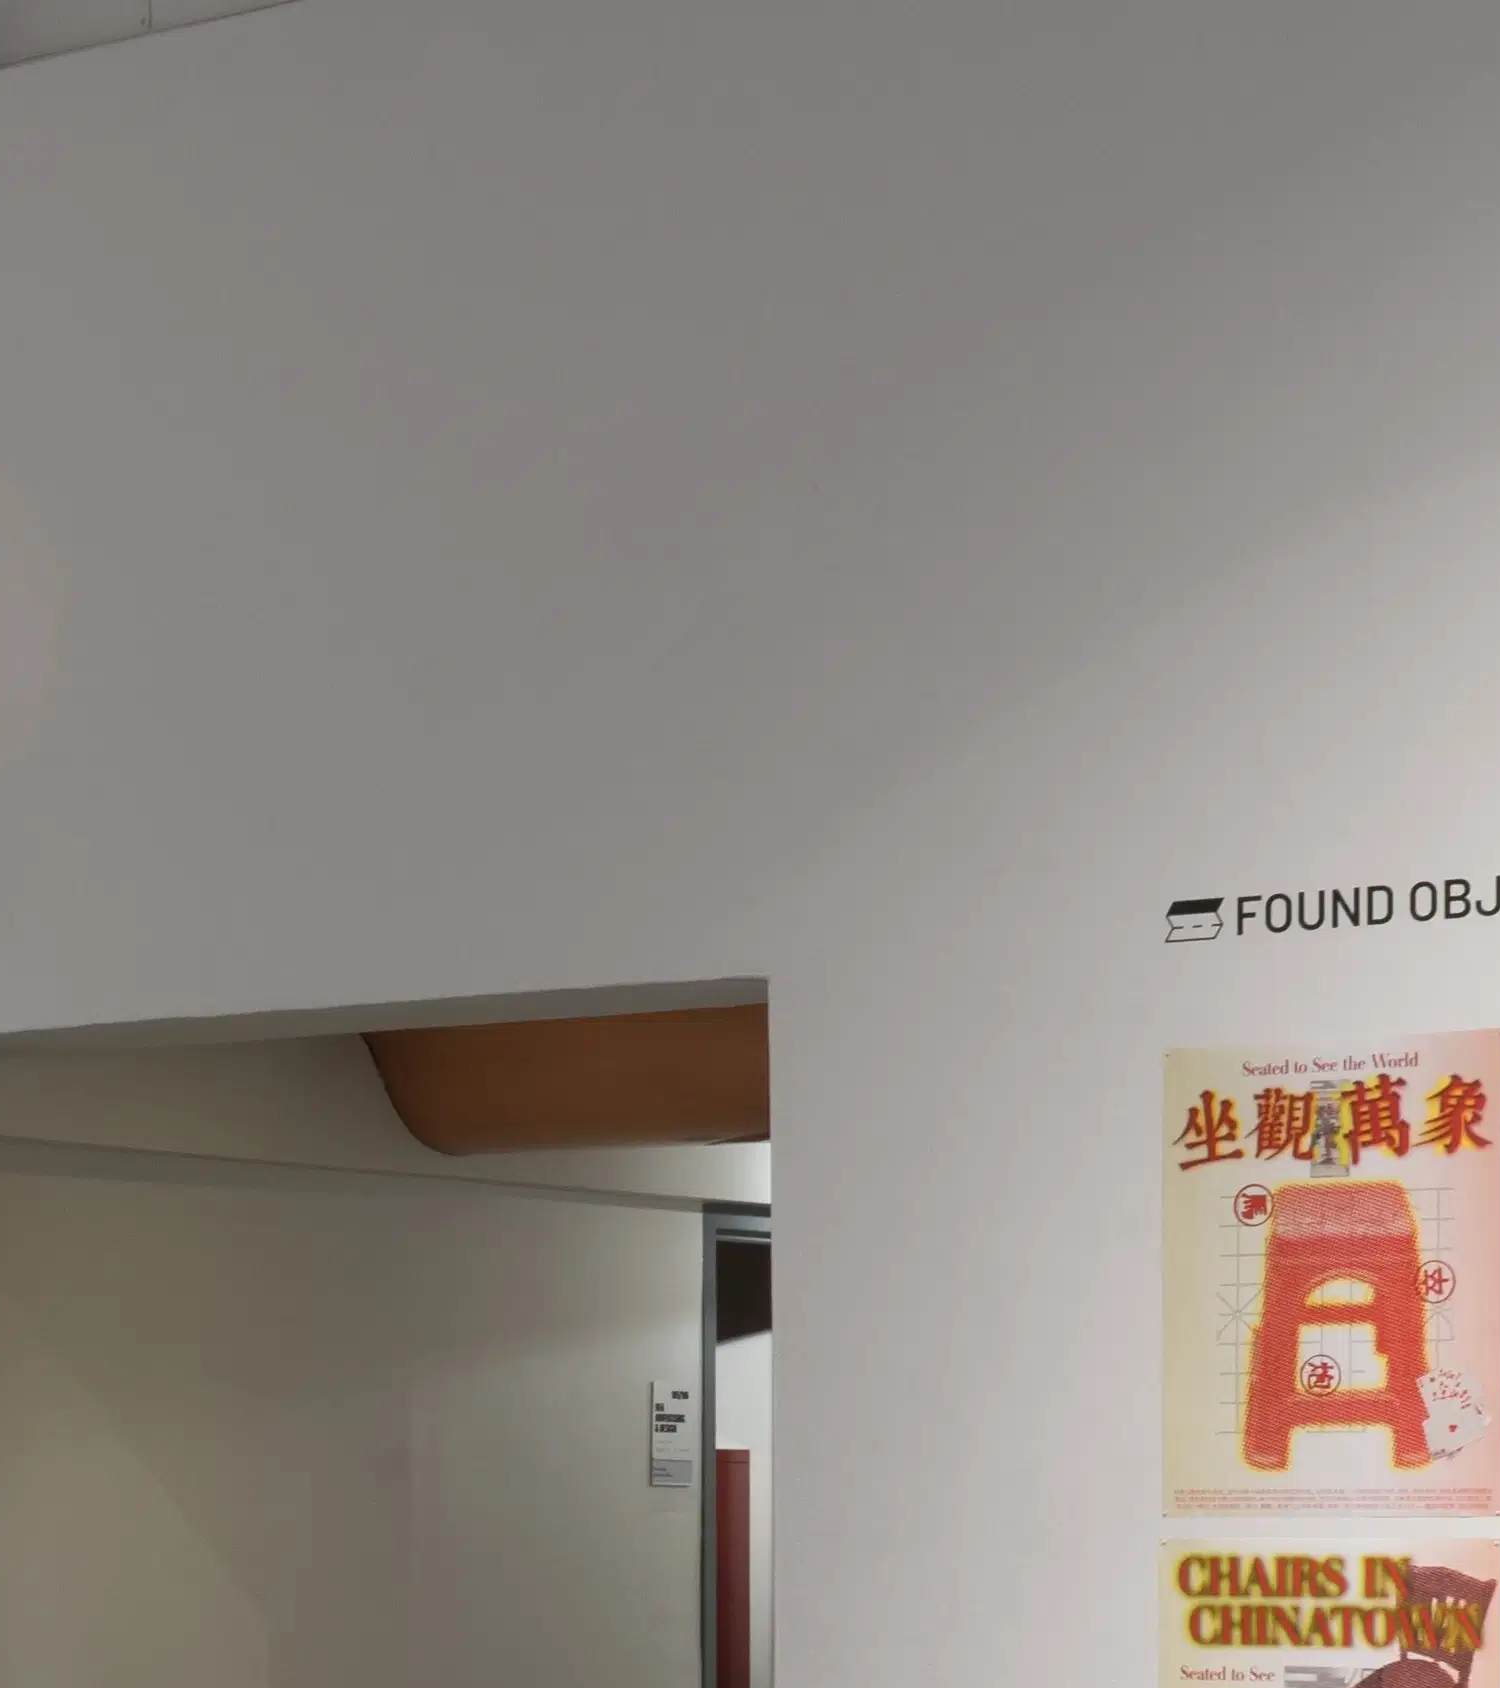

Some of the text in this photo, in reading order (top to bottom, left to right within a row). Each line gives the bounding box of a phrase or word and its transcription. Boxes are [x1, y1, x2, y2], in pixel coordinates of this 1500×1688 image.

[1236, 884, 1394, 936] FOUND
[1242, 1051, 1420, 1077] Seated to See the World
[1172, 1072, 1494, 1172] 坐觀萬象
[1175, 1553, 1411, 1600] CHAIRS IN
[1187, 1603, 1486, 1650] CHINATOWN
[1180, 1665, 1275, 1683] Seated to See
